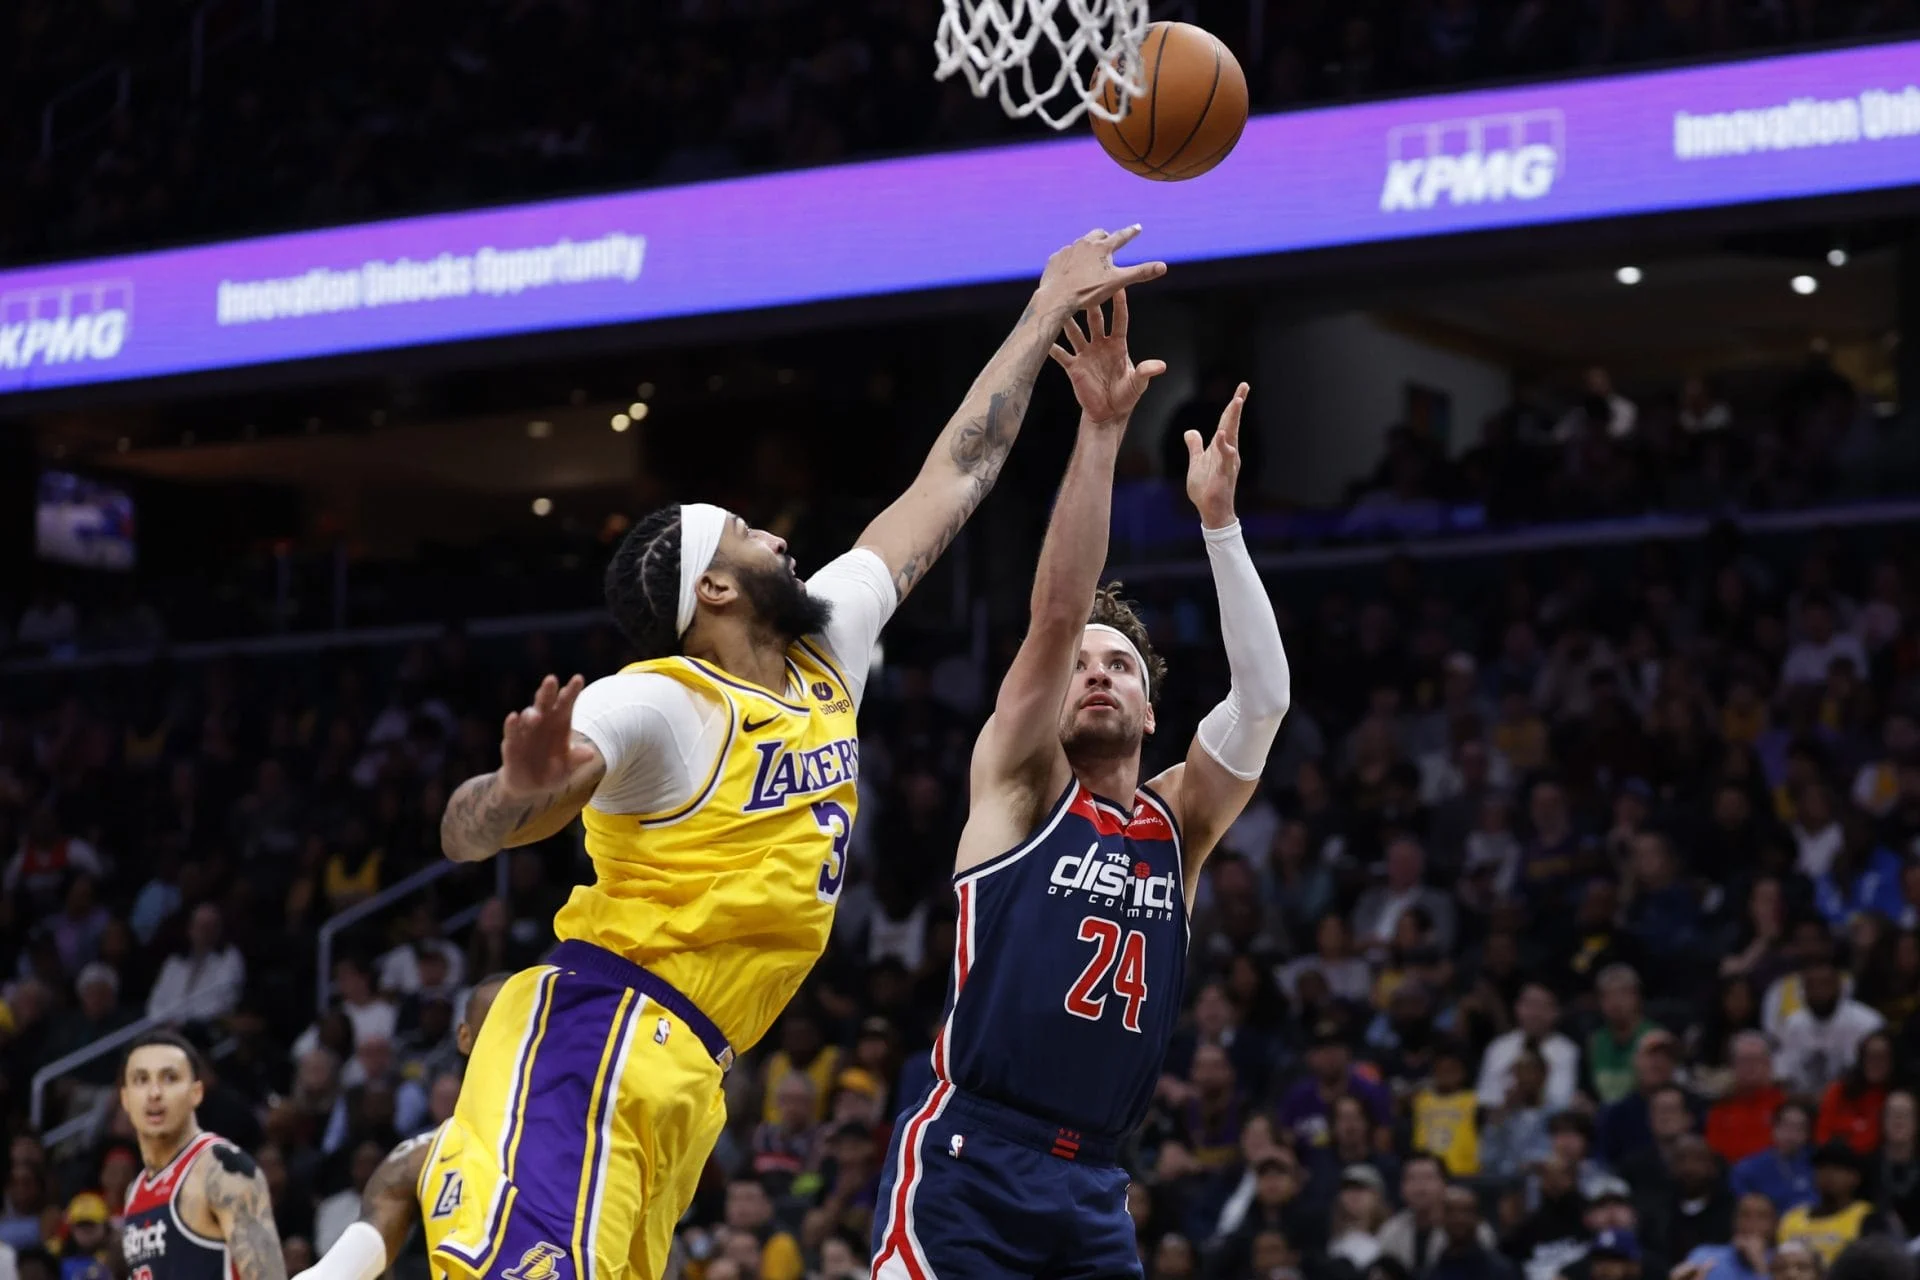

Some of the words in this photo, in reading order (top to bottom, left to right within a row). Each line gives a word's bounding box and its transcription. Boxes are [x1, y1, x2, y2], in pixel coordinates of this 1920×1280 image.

[1674, 97, 1858, 160] Innovation
[1379, 143, 1558, 214] KPMG
[216, 266, 361, 327] Innovation
[361, 253, 472, 308] Unlocks
[473, 230, 648, 298] Opportunity
[809, 799, 852, 902] 3
[1047, 885, 1073, 898] OF
[1064, 915, 1148, 1034] 24
